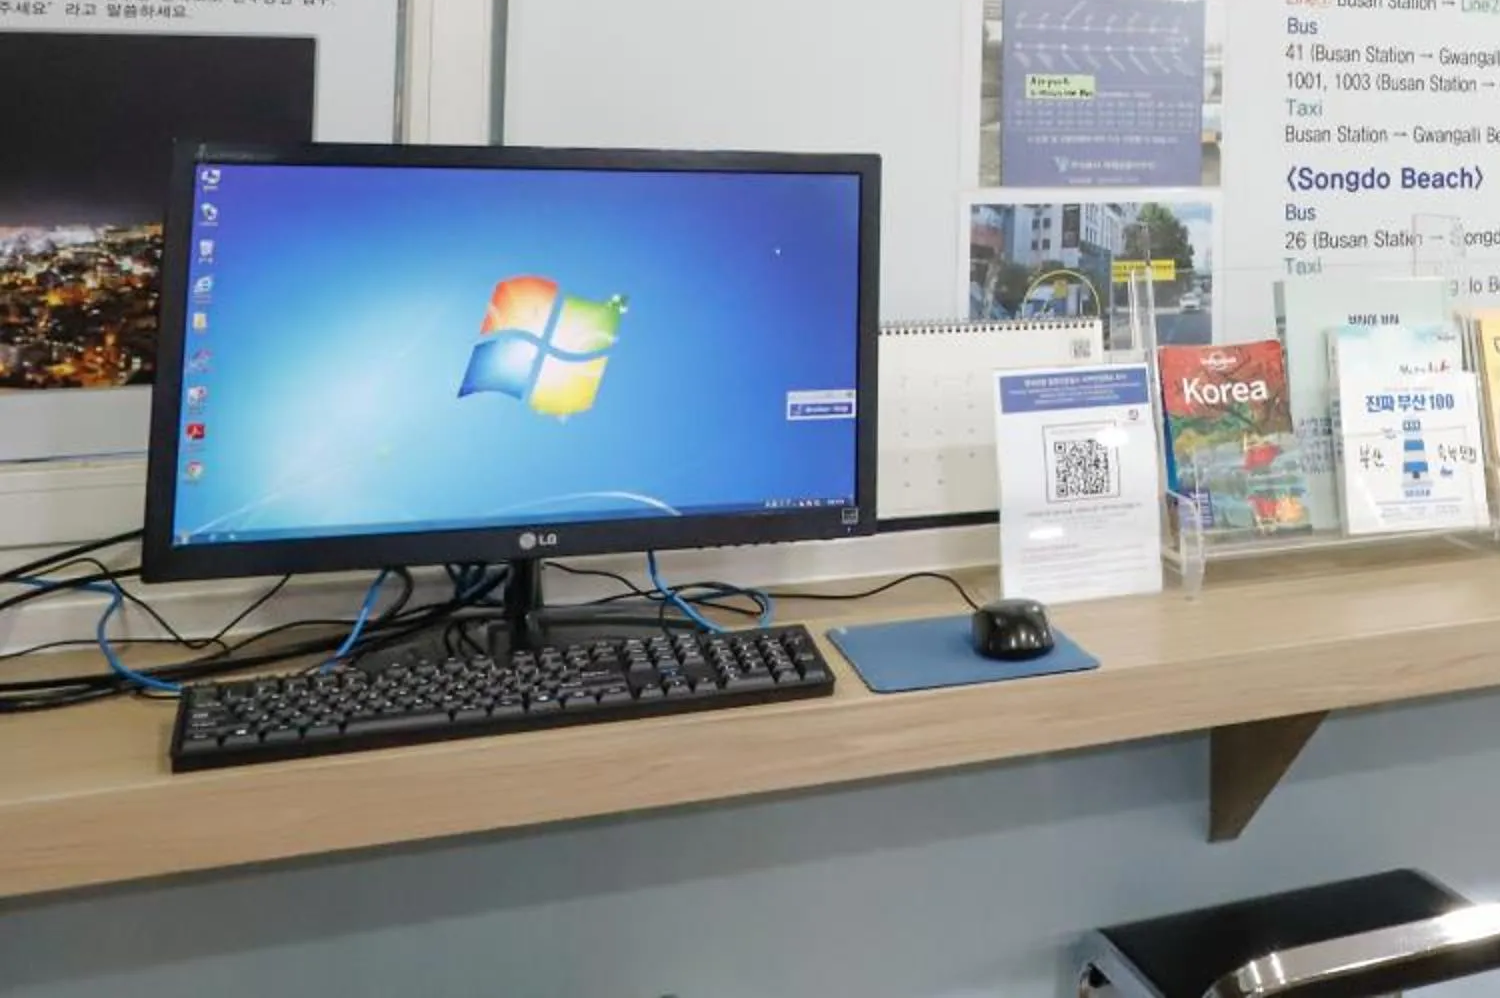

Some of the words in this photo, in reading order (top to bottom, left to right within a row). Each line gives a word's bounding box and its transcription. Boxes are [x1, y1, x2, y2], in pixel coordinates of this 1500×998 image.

[1285, 203, 1317, 224] Bus
[1182, 377, 1268, 405] Korea
[1429, 393, 1455, 411] 100
[538, 533, 557, 546] LG
